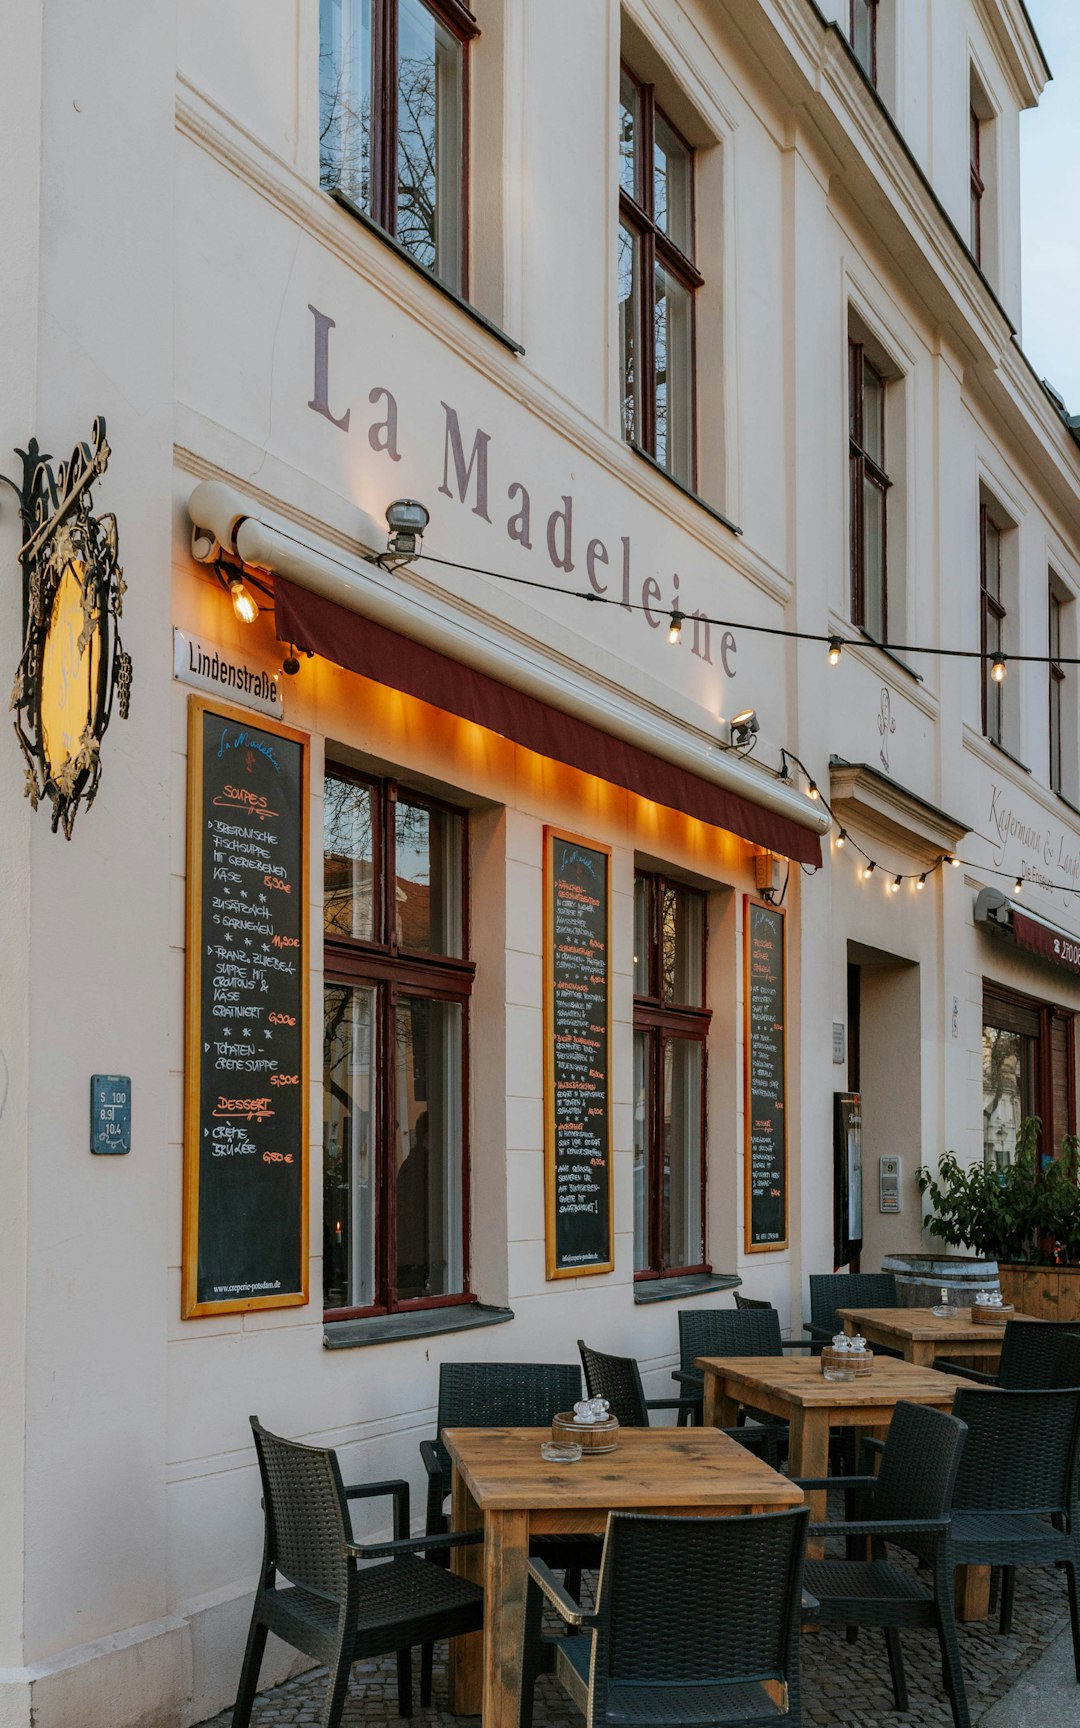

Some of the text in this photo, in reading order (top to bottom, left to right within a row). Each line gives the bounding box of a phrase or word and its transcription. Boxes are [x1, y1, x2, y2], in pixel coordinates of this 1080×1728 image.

[307, 304, 737, 678] La Madeleine
[189, 641, 277, 703] Lindenstraße
[223, 785, 268, 807] SOUPES
[213, 820, 279, 845] BRETONISCHE
[212, 834, 271, 859] FISCHSUPPE
[213, 850, 227, 863] MIT
[213, 867, 243, 883] KÄSE
[222, 916, 274, 936] GARNELEN
[216, 963, 267, 980] SUPPE MIT
[260, 980, 269, 994] &
[213, 988, 240, 1003] KÄSE
[112, 1092, 126, 1104] 100
[217, 1096, 272, 1111] DESSERT
[106, 1123, 121, 1135] 10,4
[213, 1280, 281, 1294] www.creperie-potsdam.de
